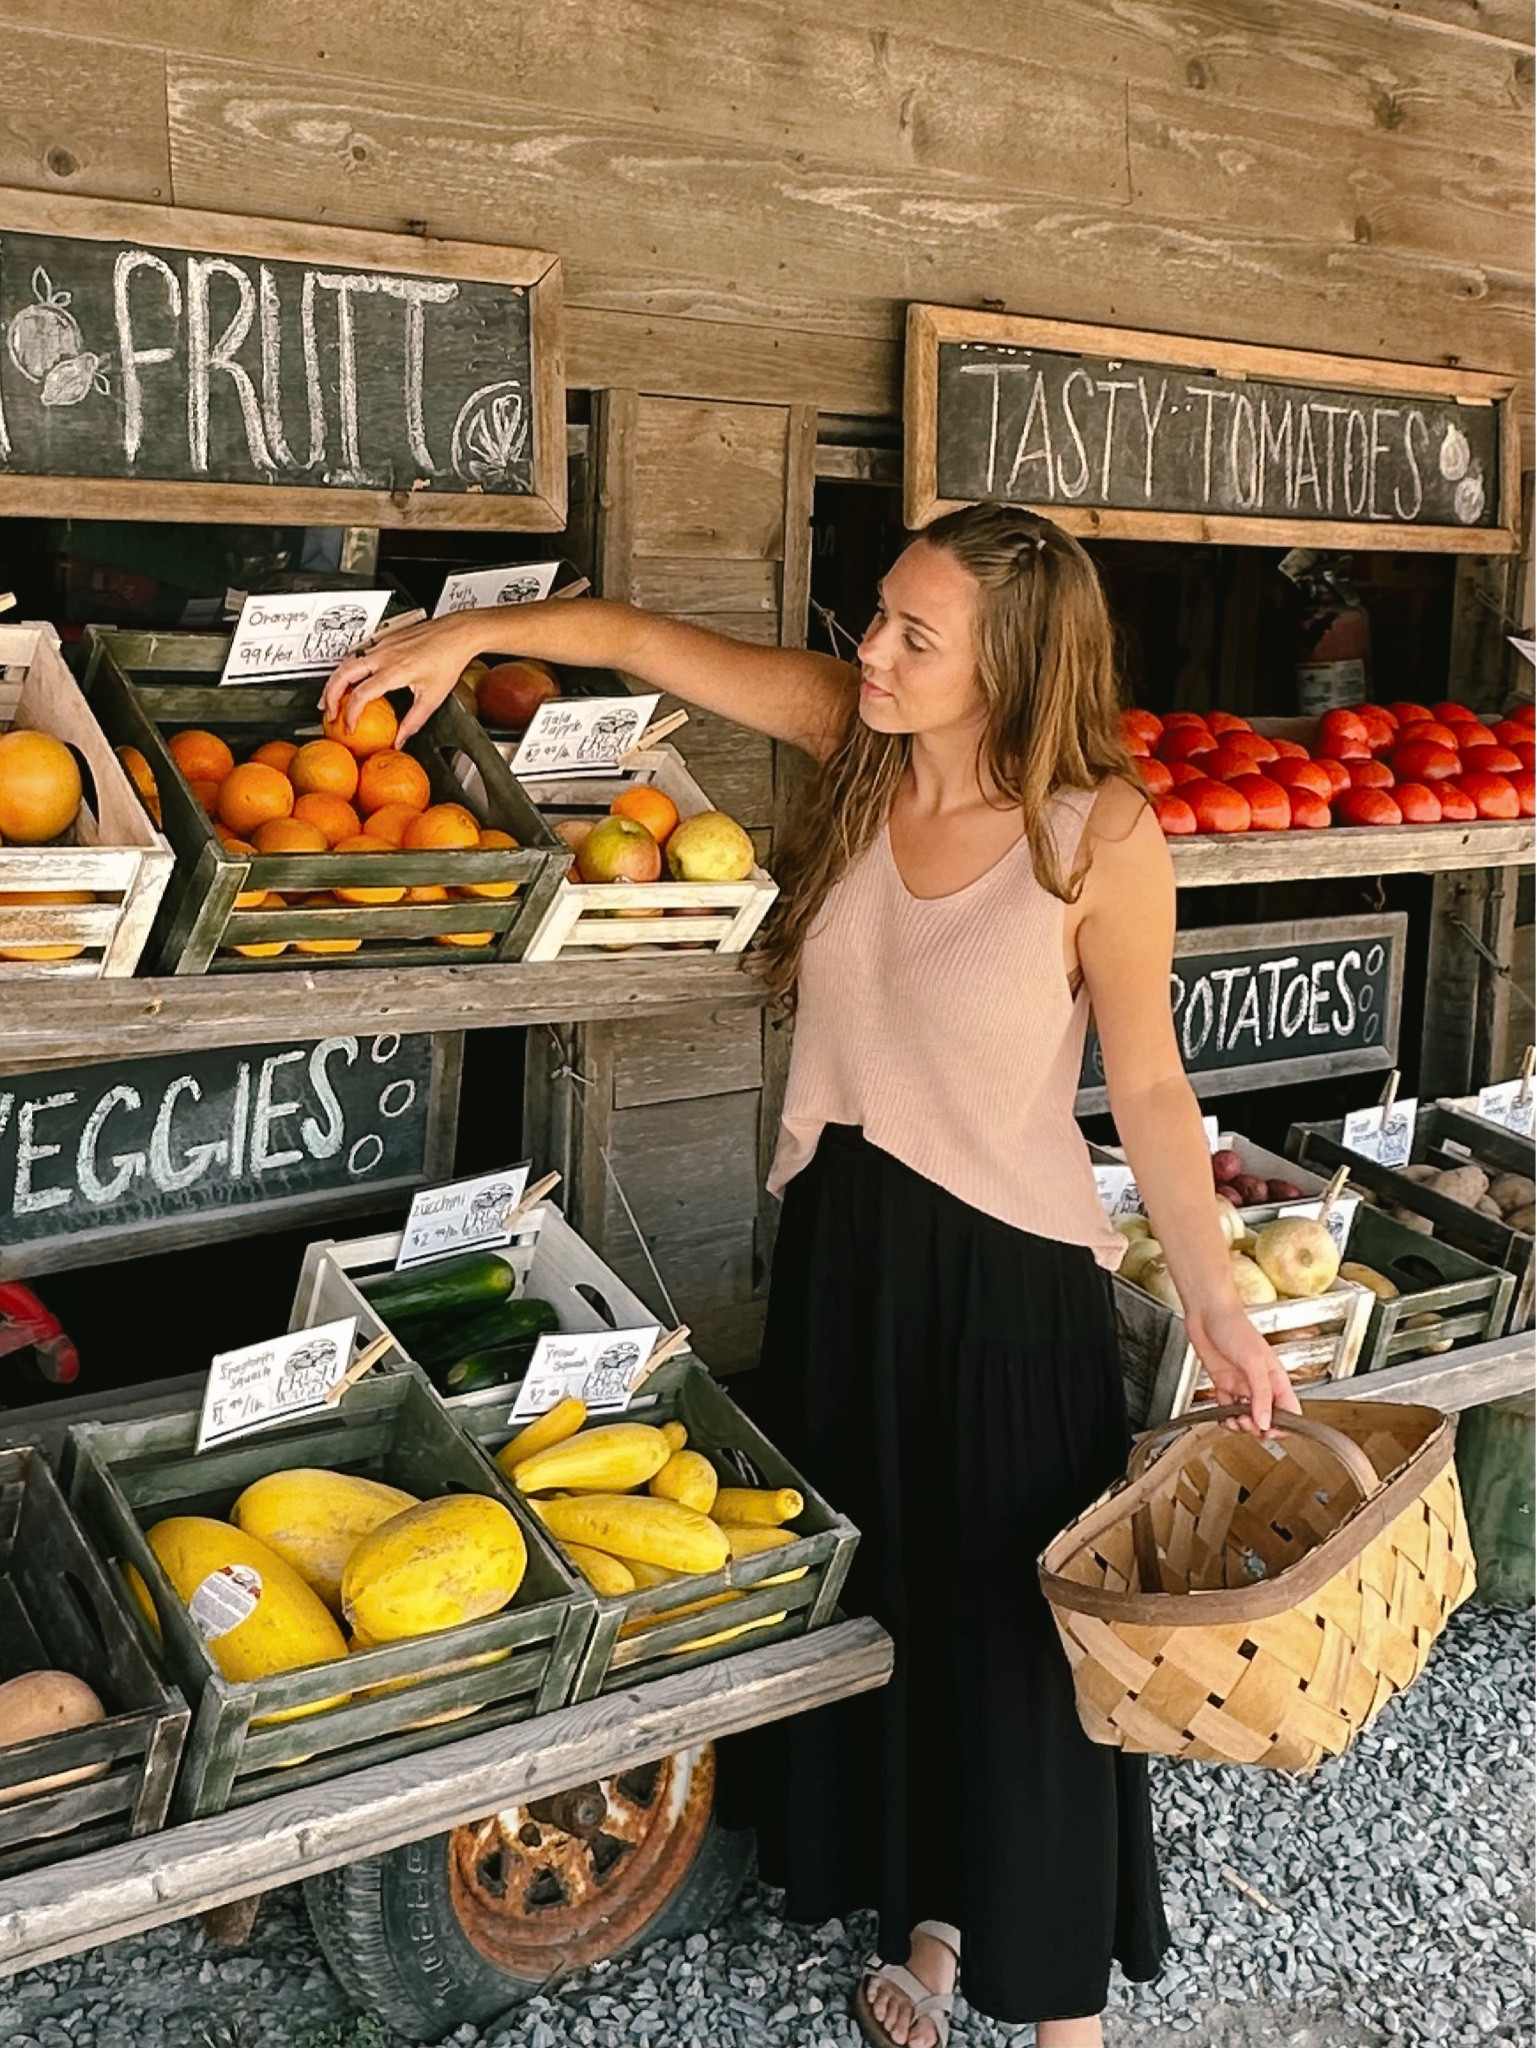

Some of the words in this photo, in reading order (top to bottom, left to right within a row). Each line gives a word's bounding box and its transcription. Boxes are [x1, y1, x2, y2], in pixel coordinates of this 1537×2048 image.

[114, 250, 460, 487] FRUIT
[960, 363, 1168, 501] TASTY
[1186, 385, 1429, 521] TOMATOES
